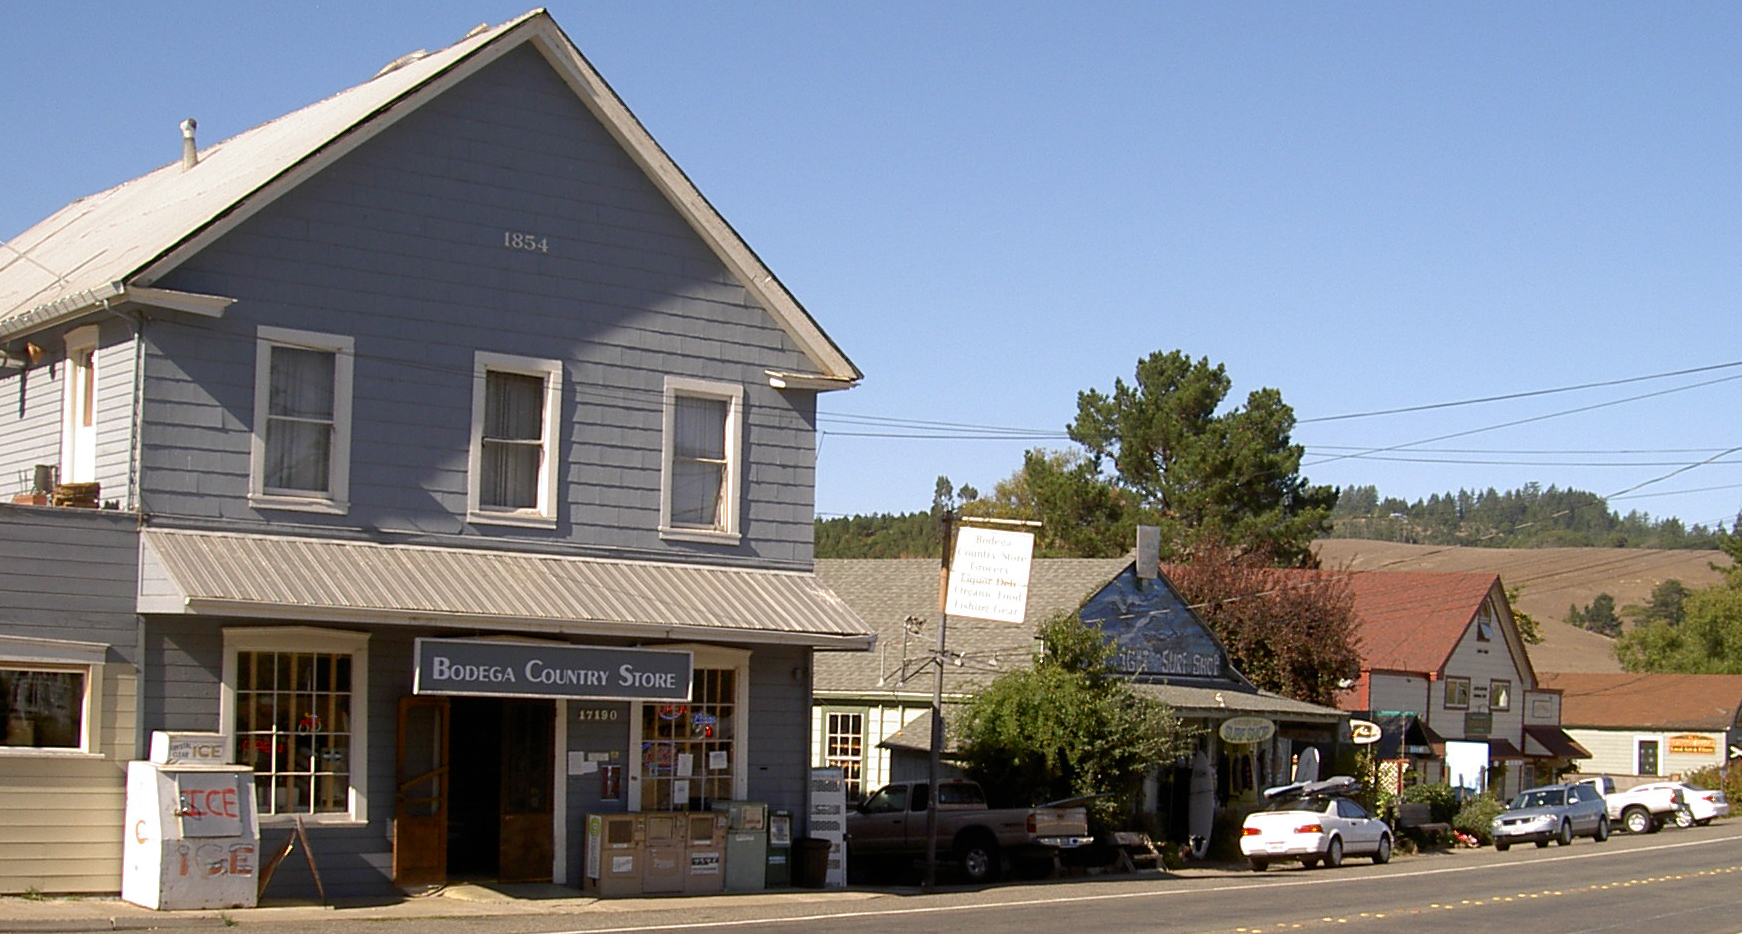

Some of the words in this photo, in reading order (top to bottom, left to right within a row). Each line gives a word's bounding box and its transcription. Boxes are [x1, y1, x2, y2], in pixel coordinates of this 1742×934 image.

[504, 231, 549, 253] 1854
[976, 535, 1012, 547] Bodega
[957, 547, 996, 560] Country
[1002, 552, 1028, 562] Store
[970, 562, 1009, 575] Grocery
[960, 572, 993, 585] Liquor
[993, 604, 1018, 615] Gear
[1161, 649, 1187, 674] SURF
[1193, 654, 1220, 675] SHOP
[579, 709, 618, 720] 17190
[192, 744, 222, 758] ICE
[179, 788, 239, 818] ICE
